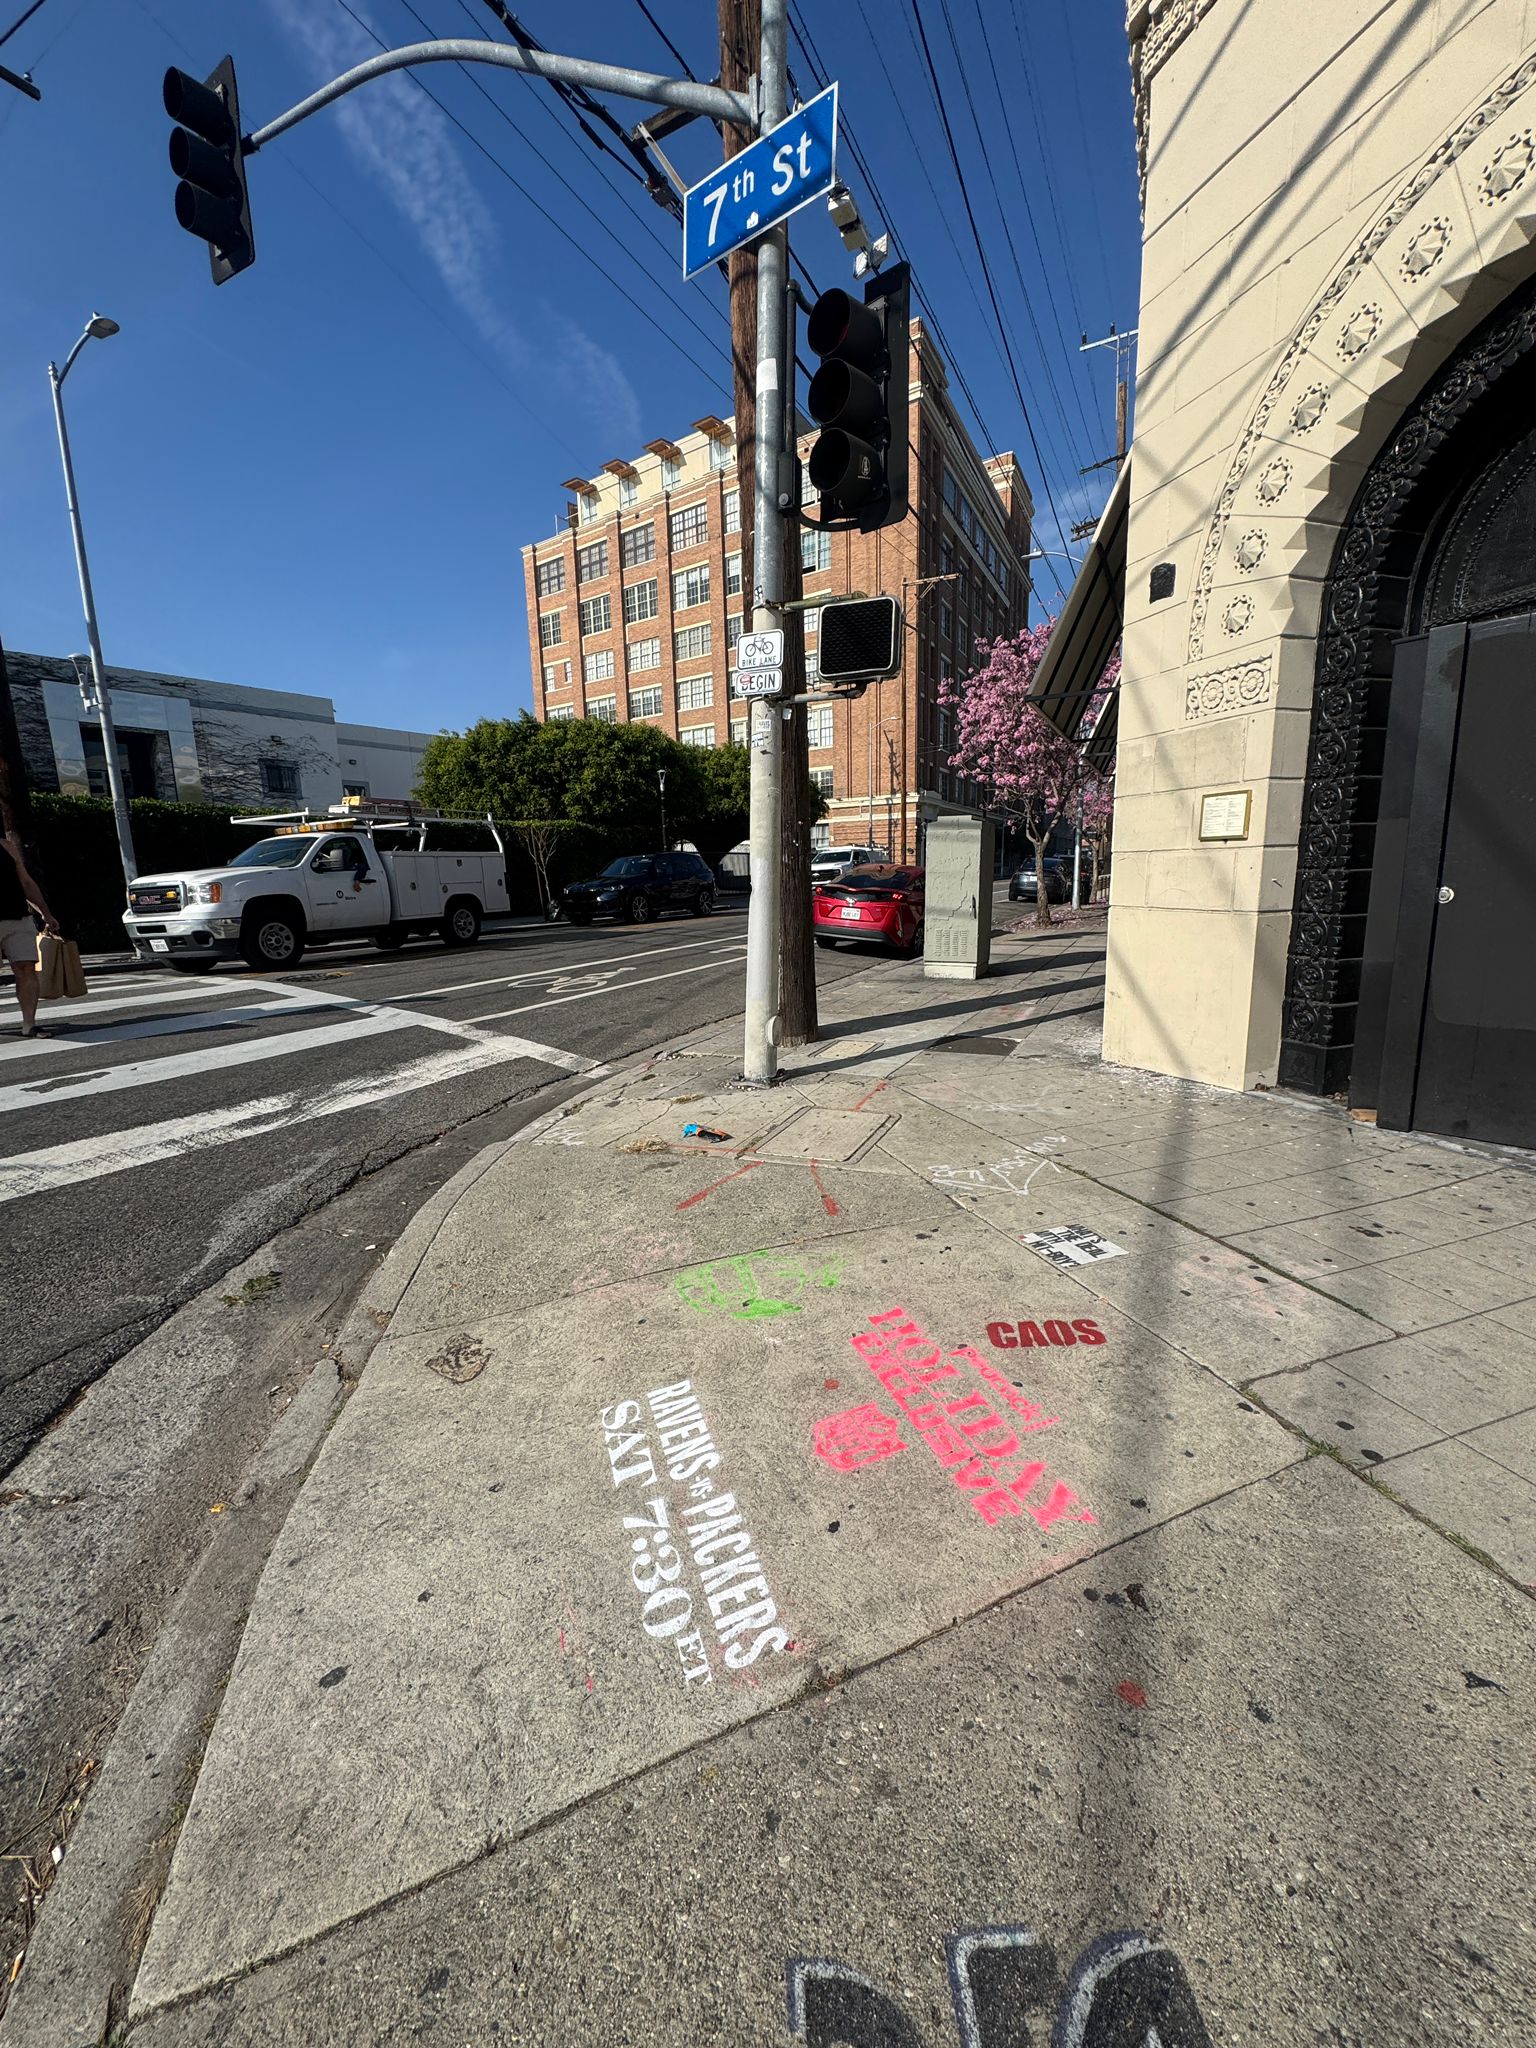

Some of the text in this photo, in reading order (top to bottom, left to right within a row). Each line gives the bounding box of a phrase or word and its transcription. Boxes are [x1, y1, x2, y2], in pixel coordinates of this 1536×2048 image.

[703, 131, 812, 247] 7th St
[742, 655, 777, 667] BIKE LANE
[1057, 1229, 1108, 1258] THE DEAL
[985, 1318, 1108, 1349] CAOS
[647, 1380, 722, 1481] RAVENS
[849, 1331, 1022, 1527] EXCLUSIVE
[868, 1305, 1099, 1533] HOLIDAY
[600, 1400, 713, 1686] SAT 7:30 ET
[682, 1492, 791, 1669] PACKERS
